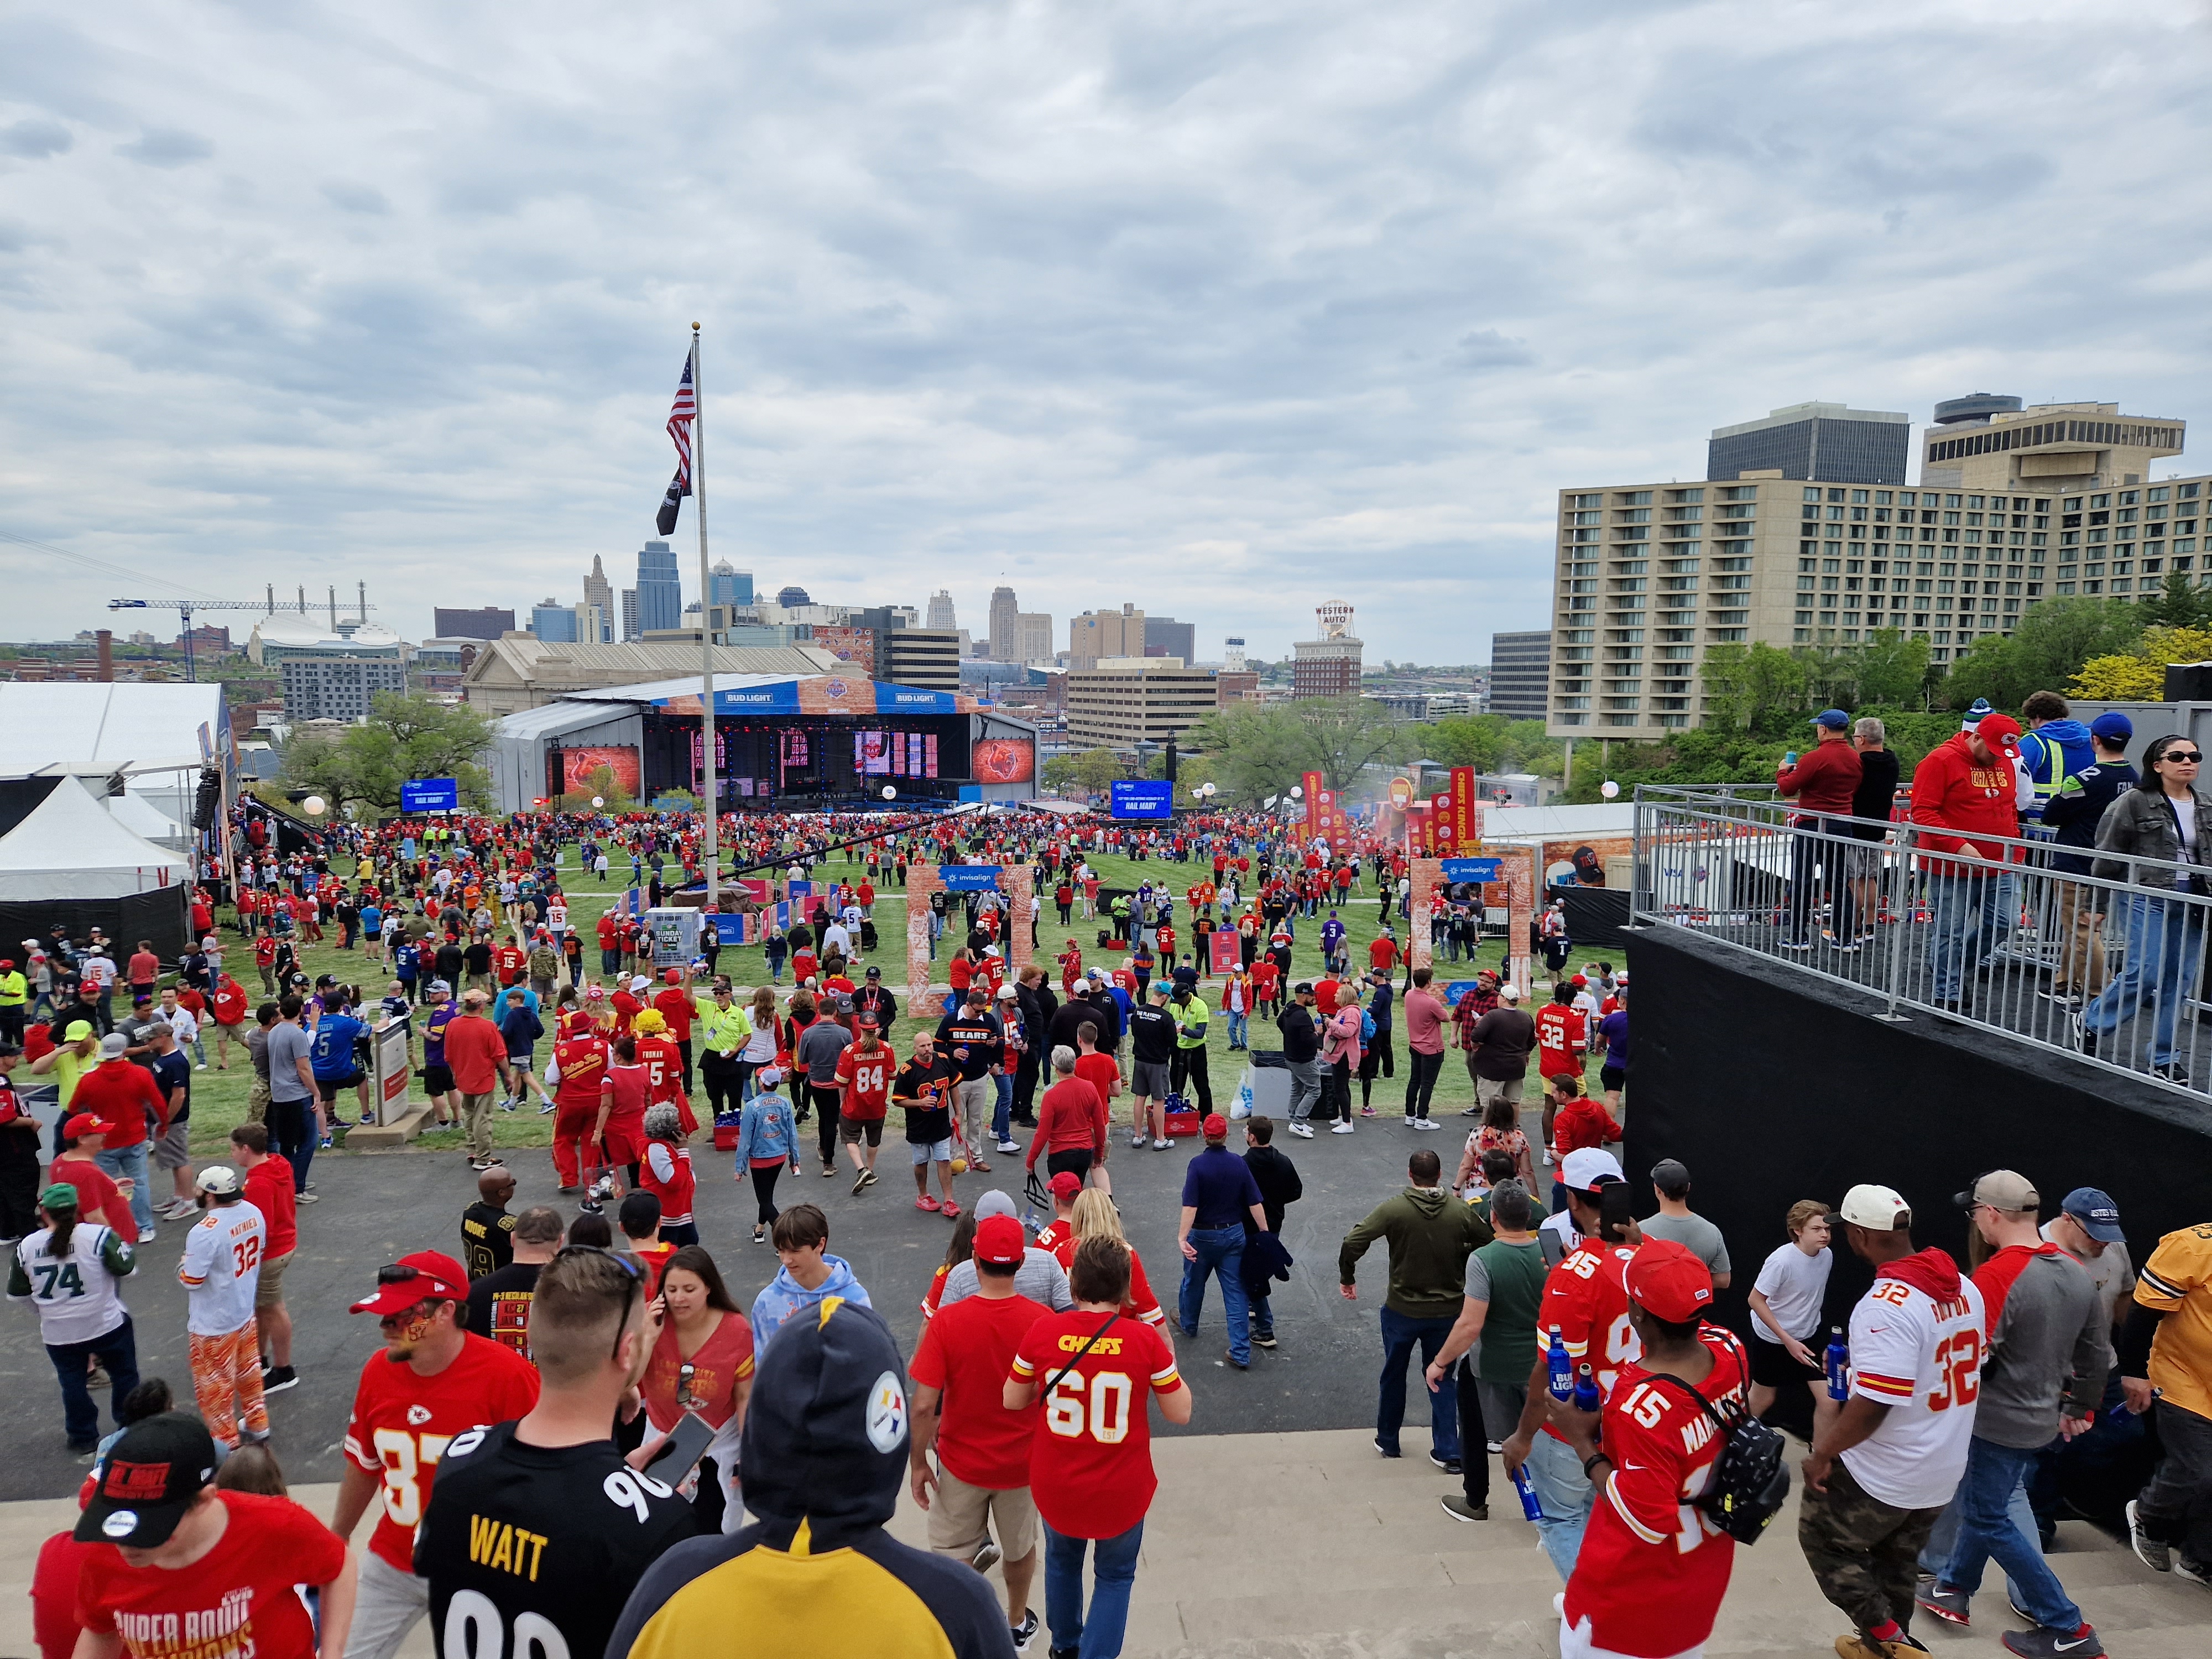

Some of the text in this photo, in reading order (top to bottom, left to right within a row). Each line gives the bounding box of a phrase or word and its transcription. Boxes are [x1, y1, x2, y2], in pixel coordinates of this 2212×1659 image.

[2077, 766, 2101, 782] 12
[1391, 784, 1409, 795] CHIEFS
[2117, 781, 2133, 794] FAN
[1663, 868, 1683, 877] VISA
[841, 890, 848, 899] 15
[935, 899, 943, 907] 25
[551, 913, 562, 923] 15
[849, 913, 855, 924] 5
[1198, 924, 1209, 935] 15
[1329, 928, 1336, 937] 3
[1161, 934, 1168, 943] 15
[1559, 945, 1565, 956] 1
[398, 953, 408, 966] 12
[504, 957, 516, 968] 15
[91, 968, 102, 980] 15
[993, 966, 1003, 978] 15
[1142, 1011, 1162, 1020] PLAYBOOK
[1543, 1013, 1564, 1024] MATHIEU
[1004, 1022, 1018, 1045] 15
[1541, 1024, 1564, 1050] 32
[317, 1032, 332, 1057] 5
[857, 1065, 884, 1093] 84
[229, 1217, 258, 1239] MATHIEU
[465, 1219, 487, 1239] MOORE
[1039, 1226, 1057, 1245] 95
[233, 1235, 259, 1279] 32
[1561, 1250, 1601, 1280] 95
[34, 1262, 85, 1300] 74
[1872, 1282, 1911, 1306] 32
[1927, 1328, 1981, 1412] 32
[1552, 1381, 1574, 1390] LIGH
[1046, 1368, 1133, 1444] 60
[1620, 1383, 1672, 1430] 15
[1679, 1381, 1746, 1455] MAHMES
[603, 1465, 673, 1524] 90
[471, 1514, 549, 1582] WATT
